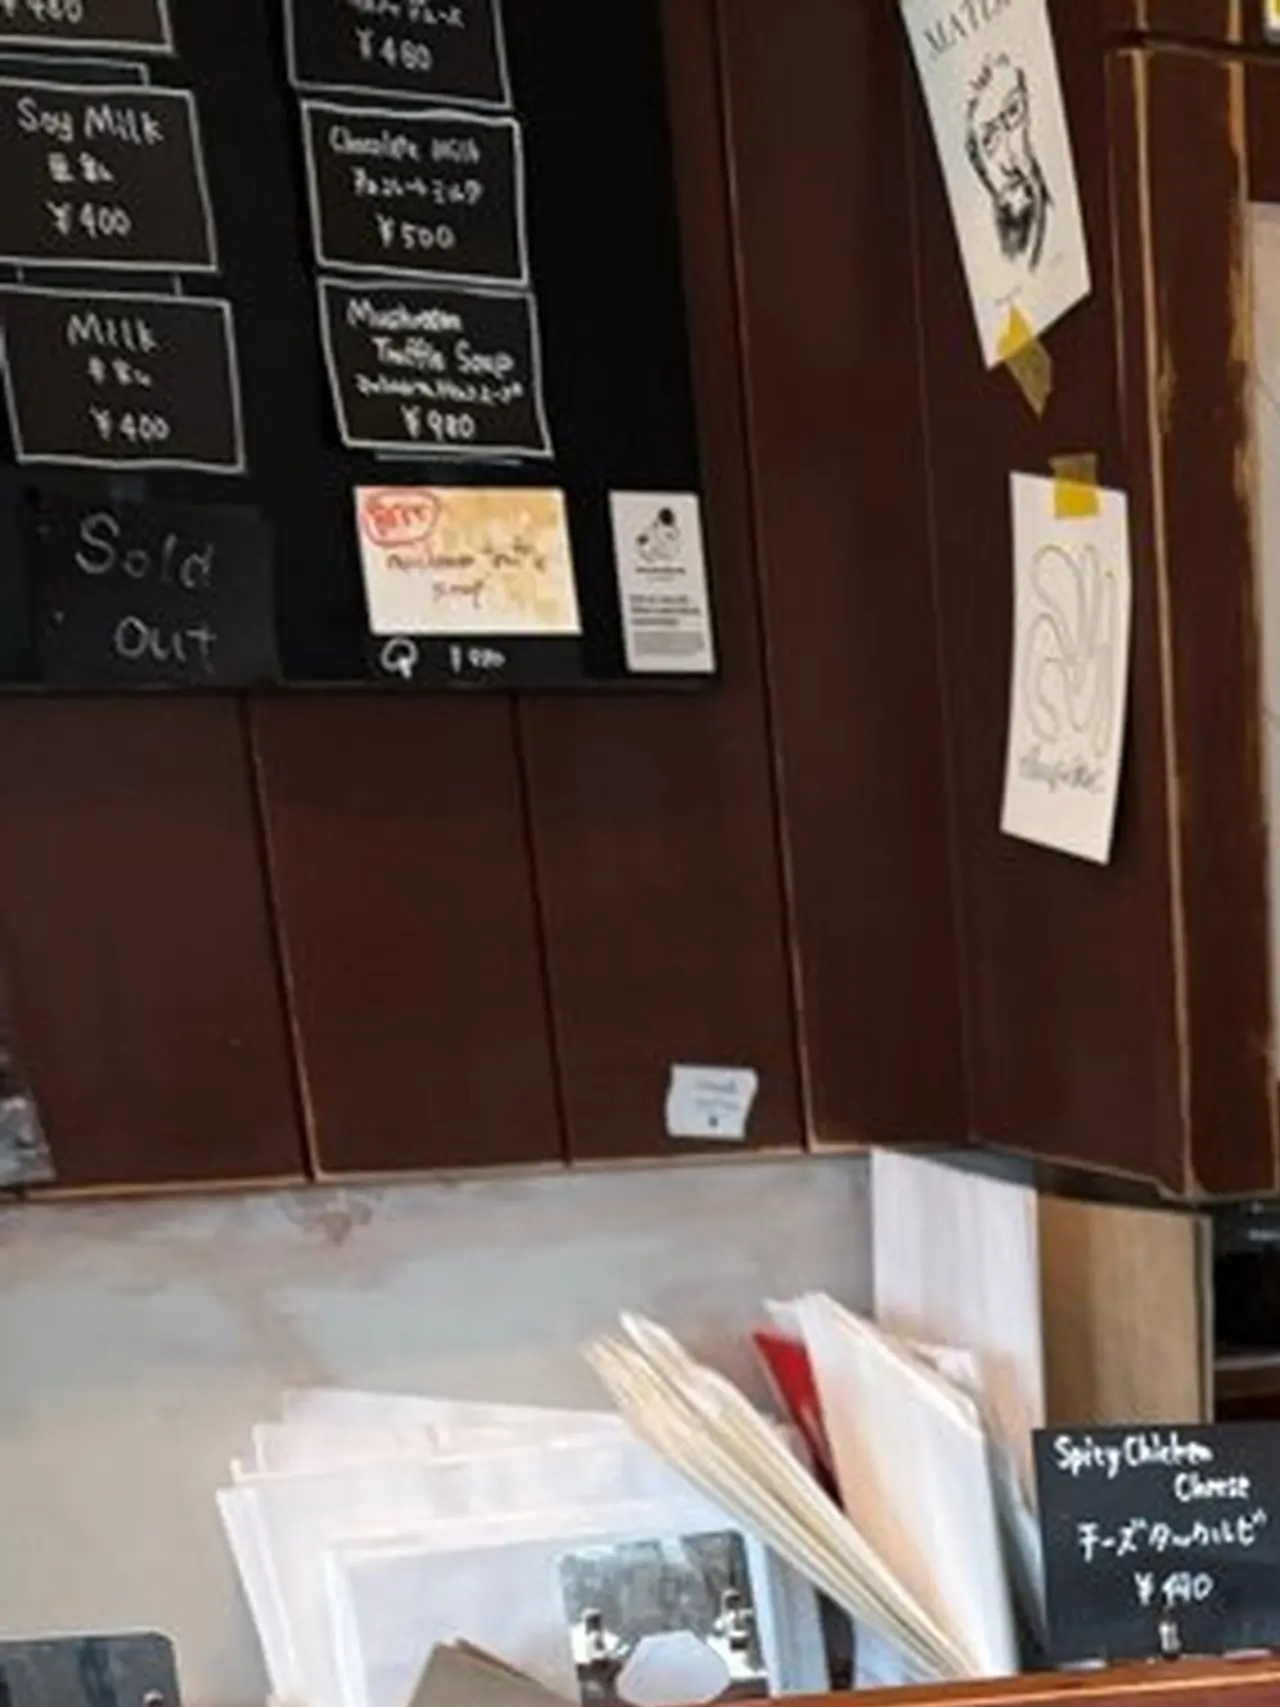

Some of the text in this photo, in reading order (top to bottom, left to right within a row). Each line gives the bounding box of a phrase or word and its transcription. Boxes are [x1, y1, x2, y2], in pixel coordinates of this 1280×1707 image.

[16, 95, 165, 145] Soy Milk
[375, 211, 456, 250] ¥500
[66, 312, 159, 353] Milk
[89, 404, 172, 444] ¥400
[74, 511, 215, 589] Sold
[112, 614, 219, 672] Out
[1053, 1434, 1121, 1481] Spicy
[1172, 1471, 1252, 1503] Cheese
